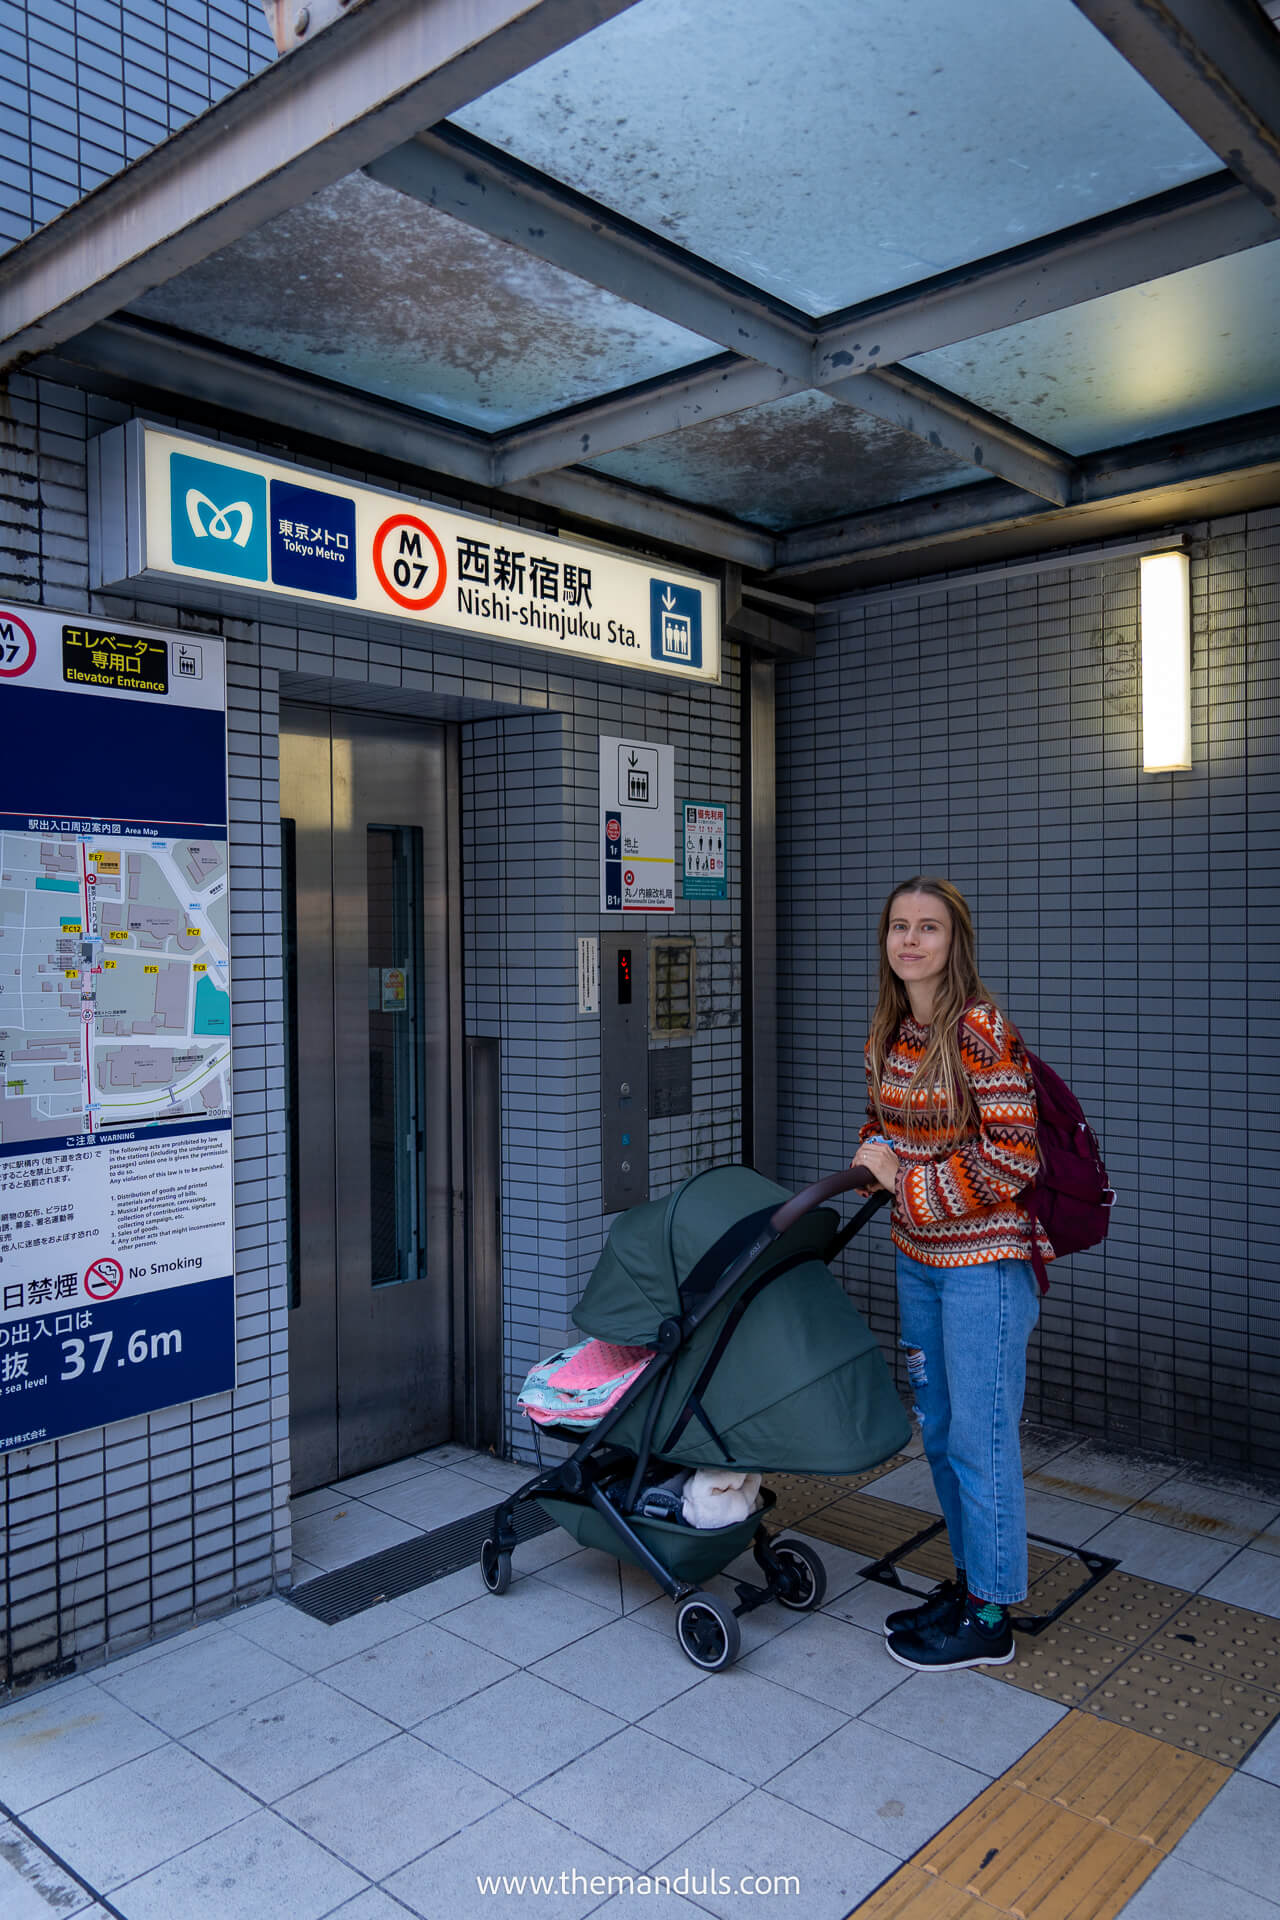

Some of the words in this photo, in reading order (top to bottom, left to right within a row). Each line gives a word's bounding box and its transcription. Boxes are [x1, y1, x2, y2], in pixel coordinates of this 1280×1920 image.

[279, 519, 349, 549] 東京メトロ
[399, 530, 423, 558] M
[283, 538, 314, 556] Tokyo
[316, 545, 345, 562] Metro
[393, 559, 429, 589] 07
[456, 536, 593, 610] 西新宿駅
[457, 586, 601, 641] Nishi-shinjuku
[607, 619, 641, 649] Sta.
[66, 630, 165, 656] エレベーター
[91, 650, 141, 674] 専用口
[67, 668, 114, 686] Elevator
[117, 675, 165, 692] Entrance
[28, 819, 121, 834] 駅出入口周辺案内図
[124, 827, 141, 835] Area
[143, 828, 158, 837] Map
[208, 1109, 228, 1117] 200m
[66, 1134, 96, 1147] ご注意
[100, 1132, 135, 1143] WARNING
[3, 1272, 78, 1311] 日禁煙
[129, 1267, 147, 1279] No
[150, 1256, 203, 1275] Smoking
[1, 1351, 29, 1382] 抜
[60, 1328, 182, 1380] 37.6m
[5, 1383, 22, 1395] sea
[24, 1375, 48, 1390] level
